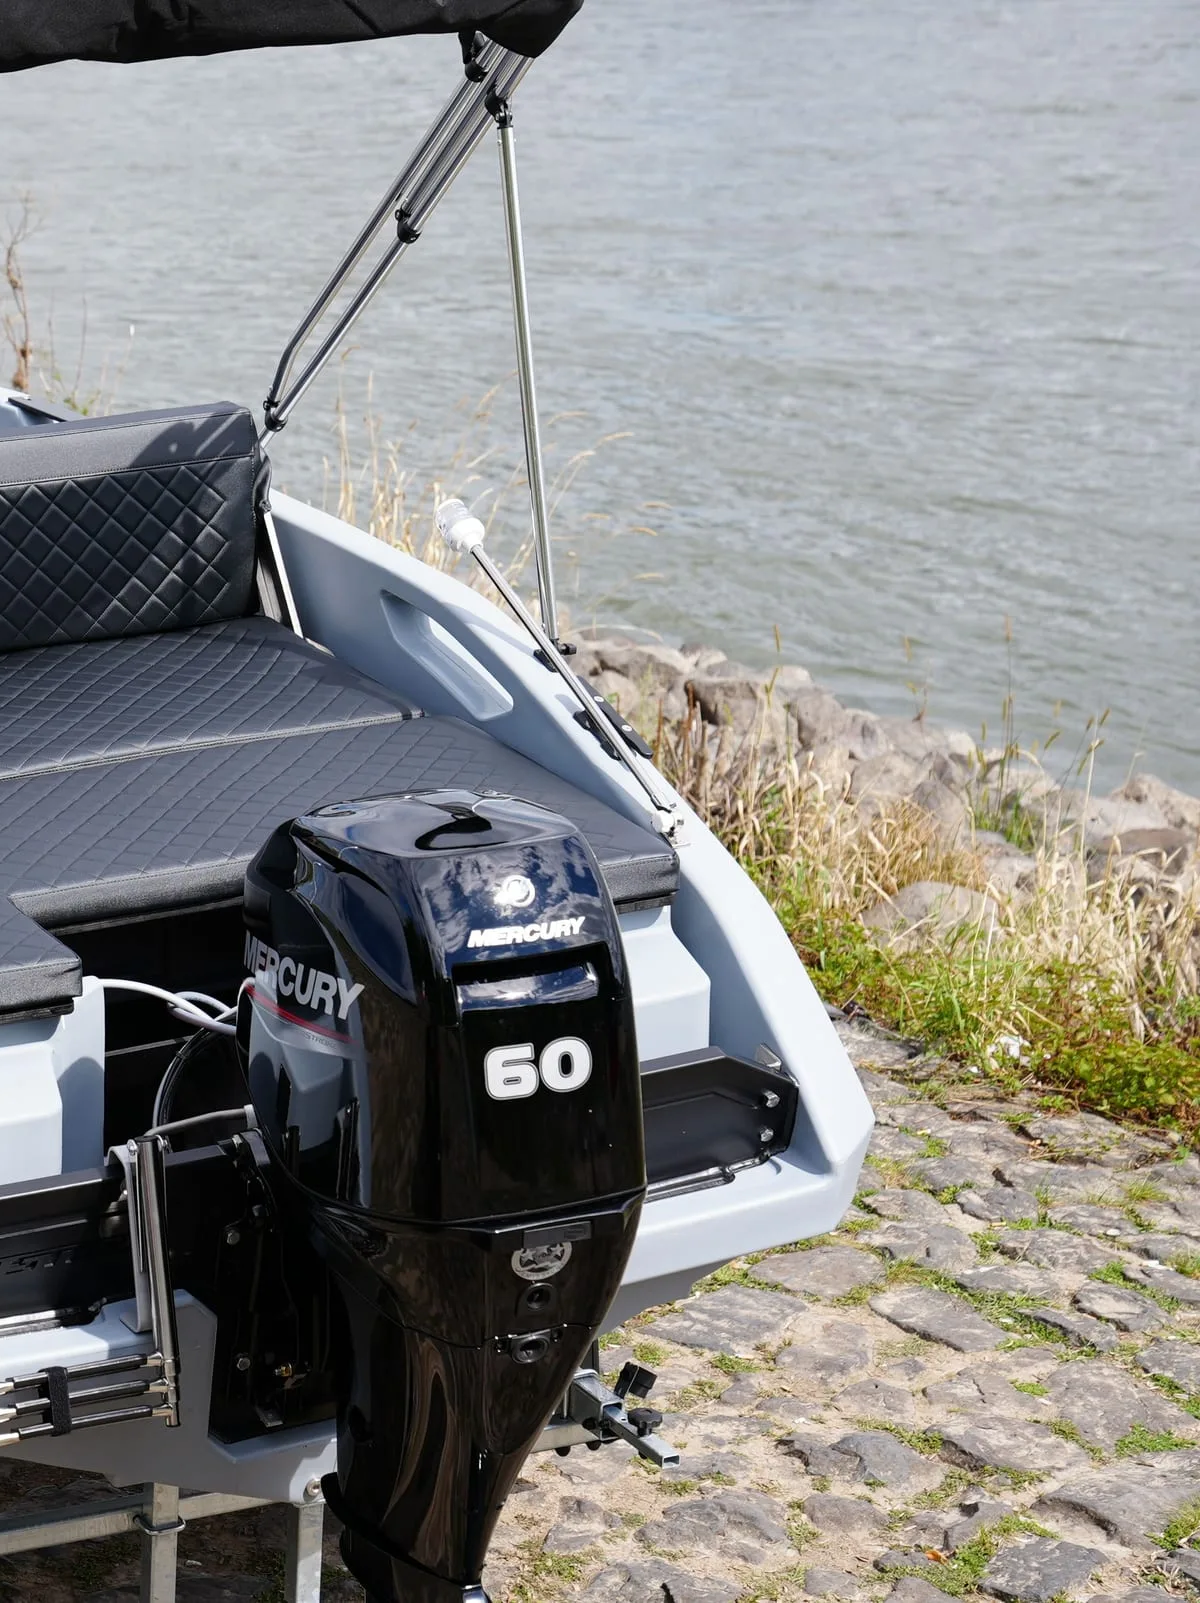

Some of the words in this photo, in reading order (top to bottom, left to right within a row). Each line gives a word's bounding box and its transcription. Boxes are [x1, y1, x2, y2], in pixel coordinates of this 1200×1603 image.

[467, 916, 586, 948] MERCURY
[244, 929, 365, 1020] MERCURY
[484, 1036, 593, 1101] 60
